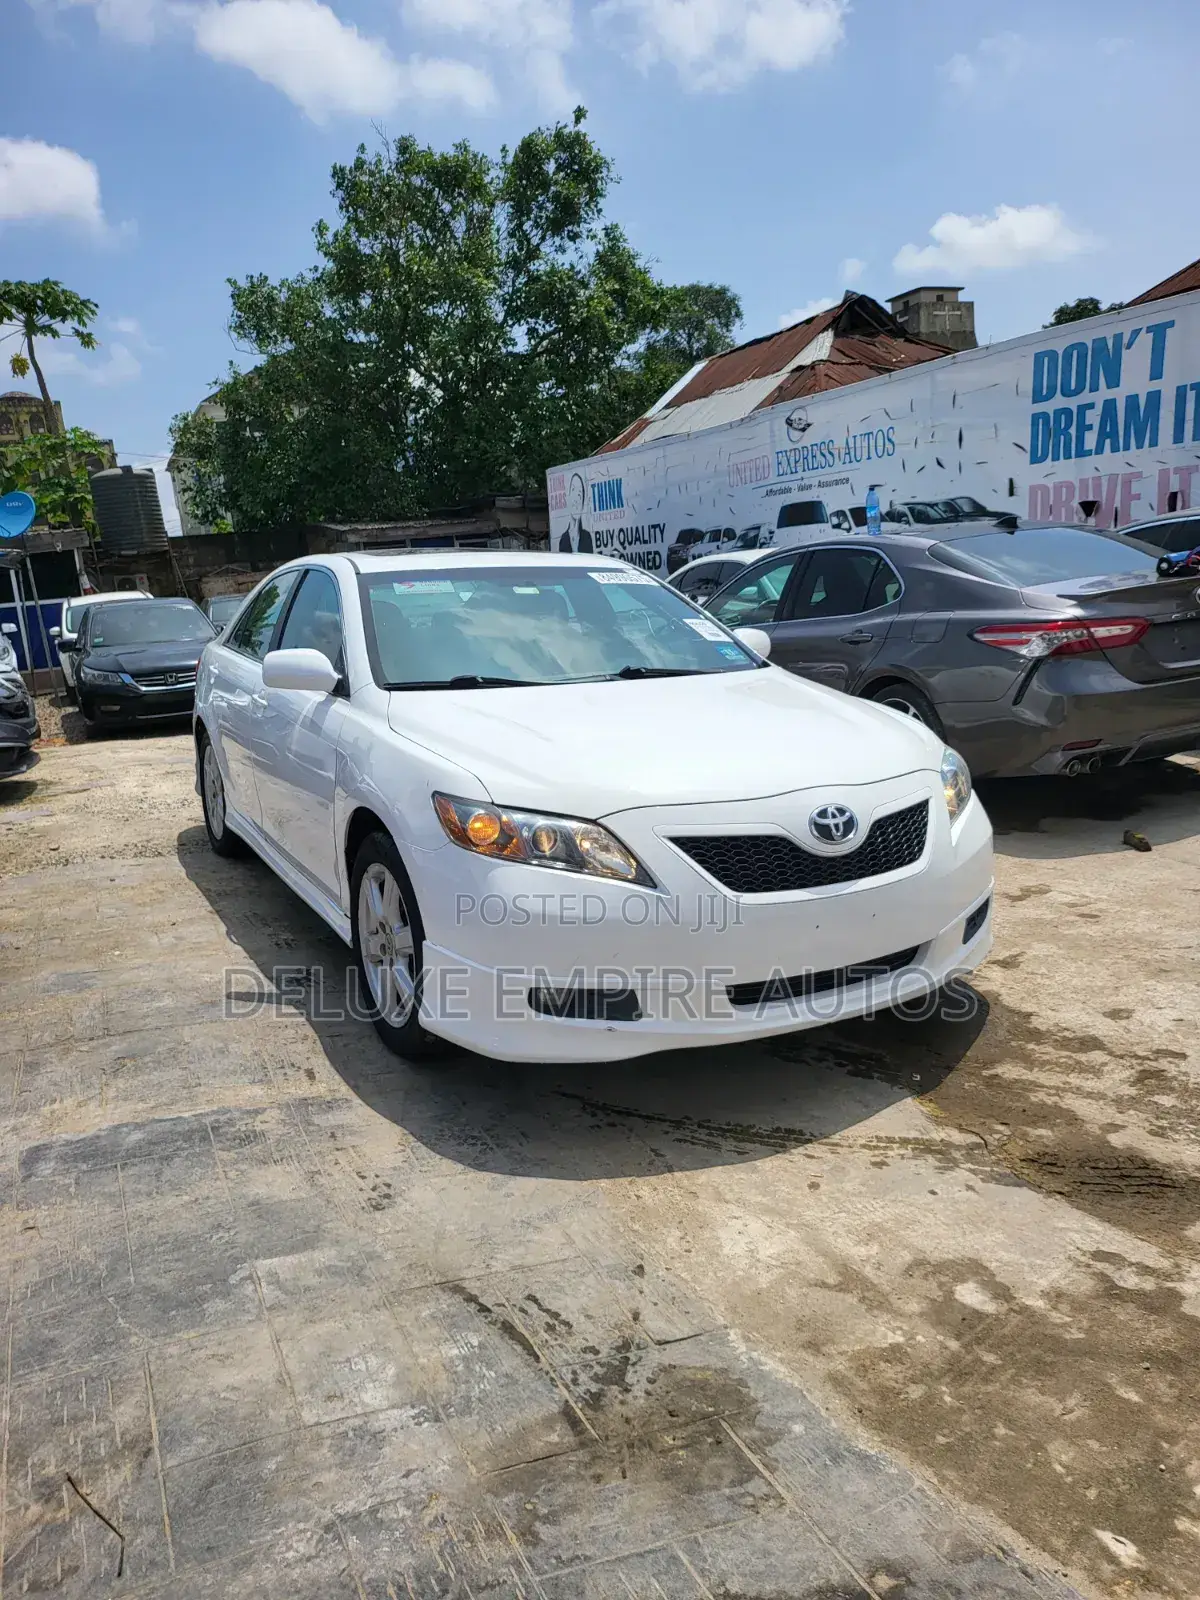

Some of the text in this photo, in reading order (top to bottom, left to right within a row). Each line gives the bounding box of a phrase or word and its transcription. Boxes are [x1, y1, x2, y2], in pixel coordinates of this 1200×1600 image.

[1032, 319, 1175, 405] DON'T
[1029, 389, 1162, 465] DREAM
[727, 426, 896, 488] UNITED EXPRESS AUTOS
[591, 477, 625, 513] THINK
[796, 482, 813, 494] Value
[817, 476, 850, 490] Assurance
[1028, 464, 1199, 529] DRIVE IT
[593, 510, 626, 523] UNITED
[595, 523, 666, 550] BUY QUALITY
